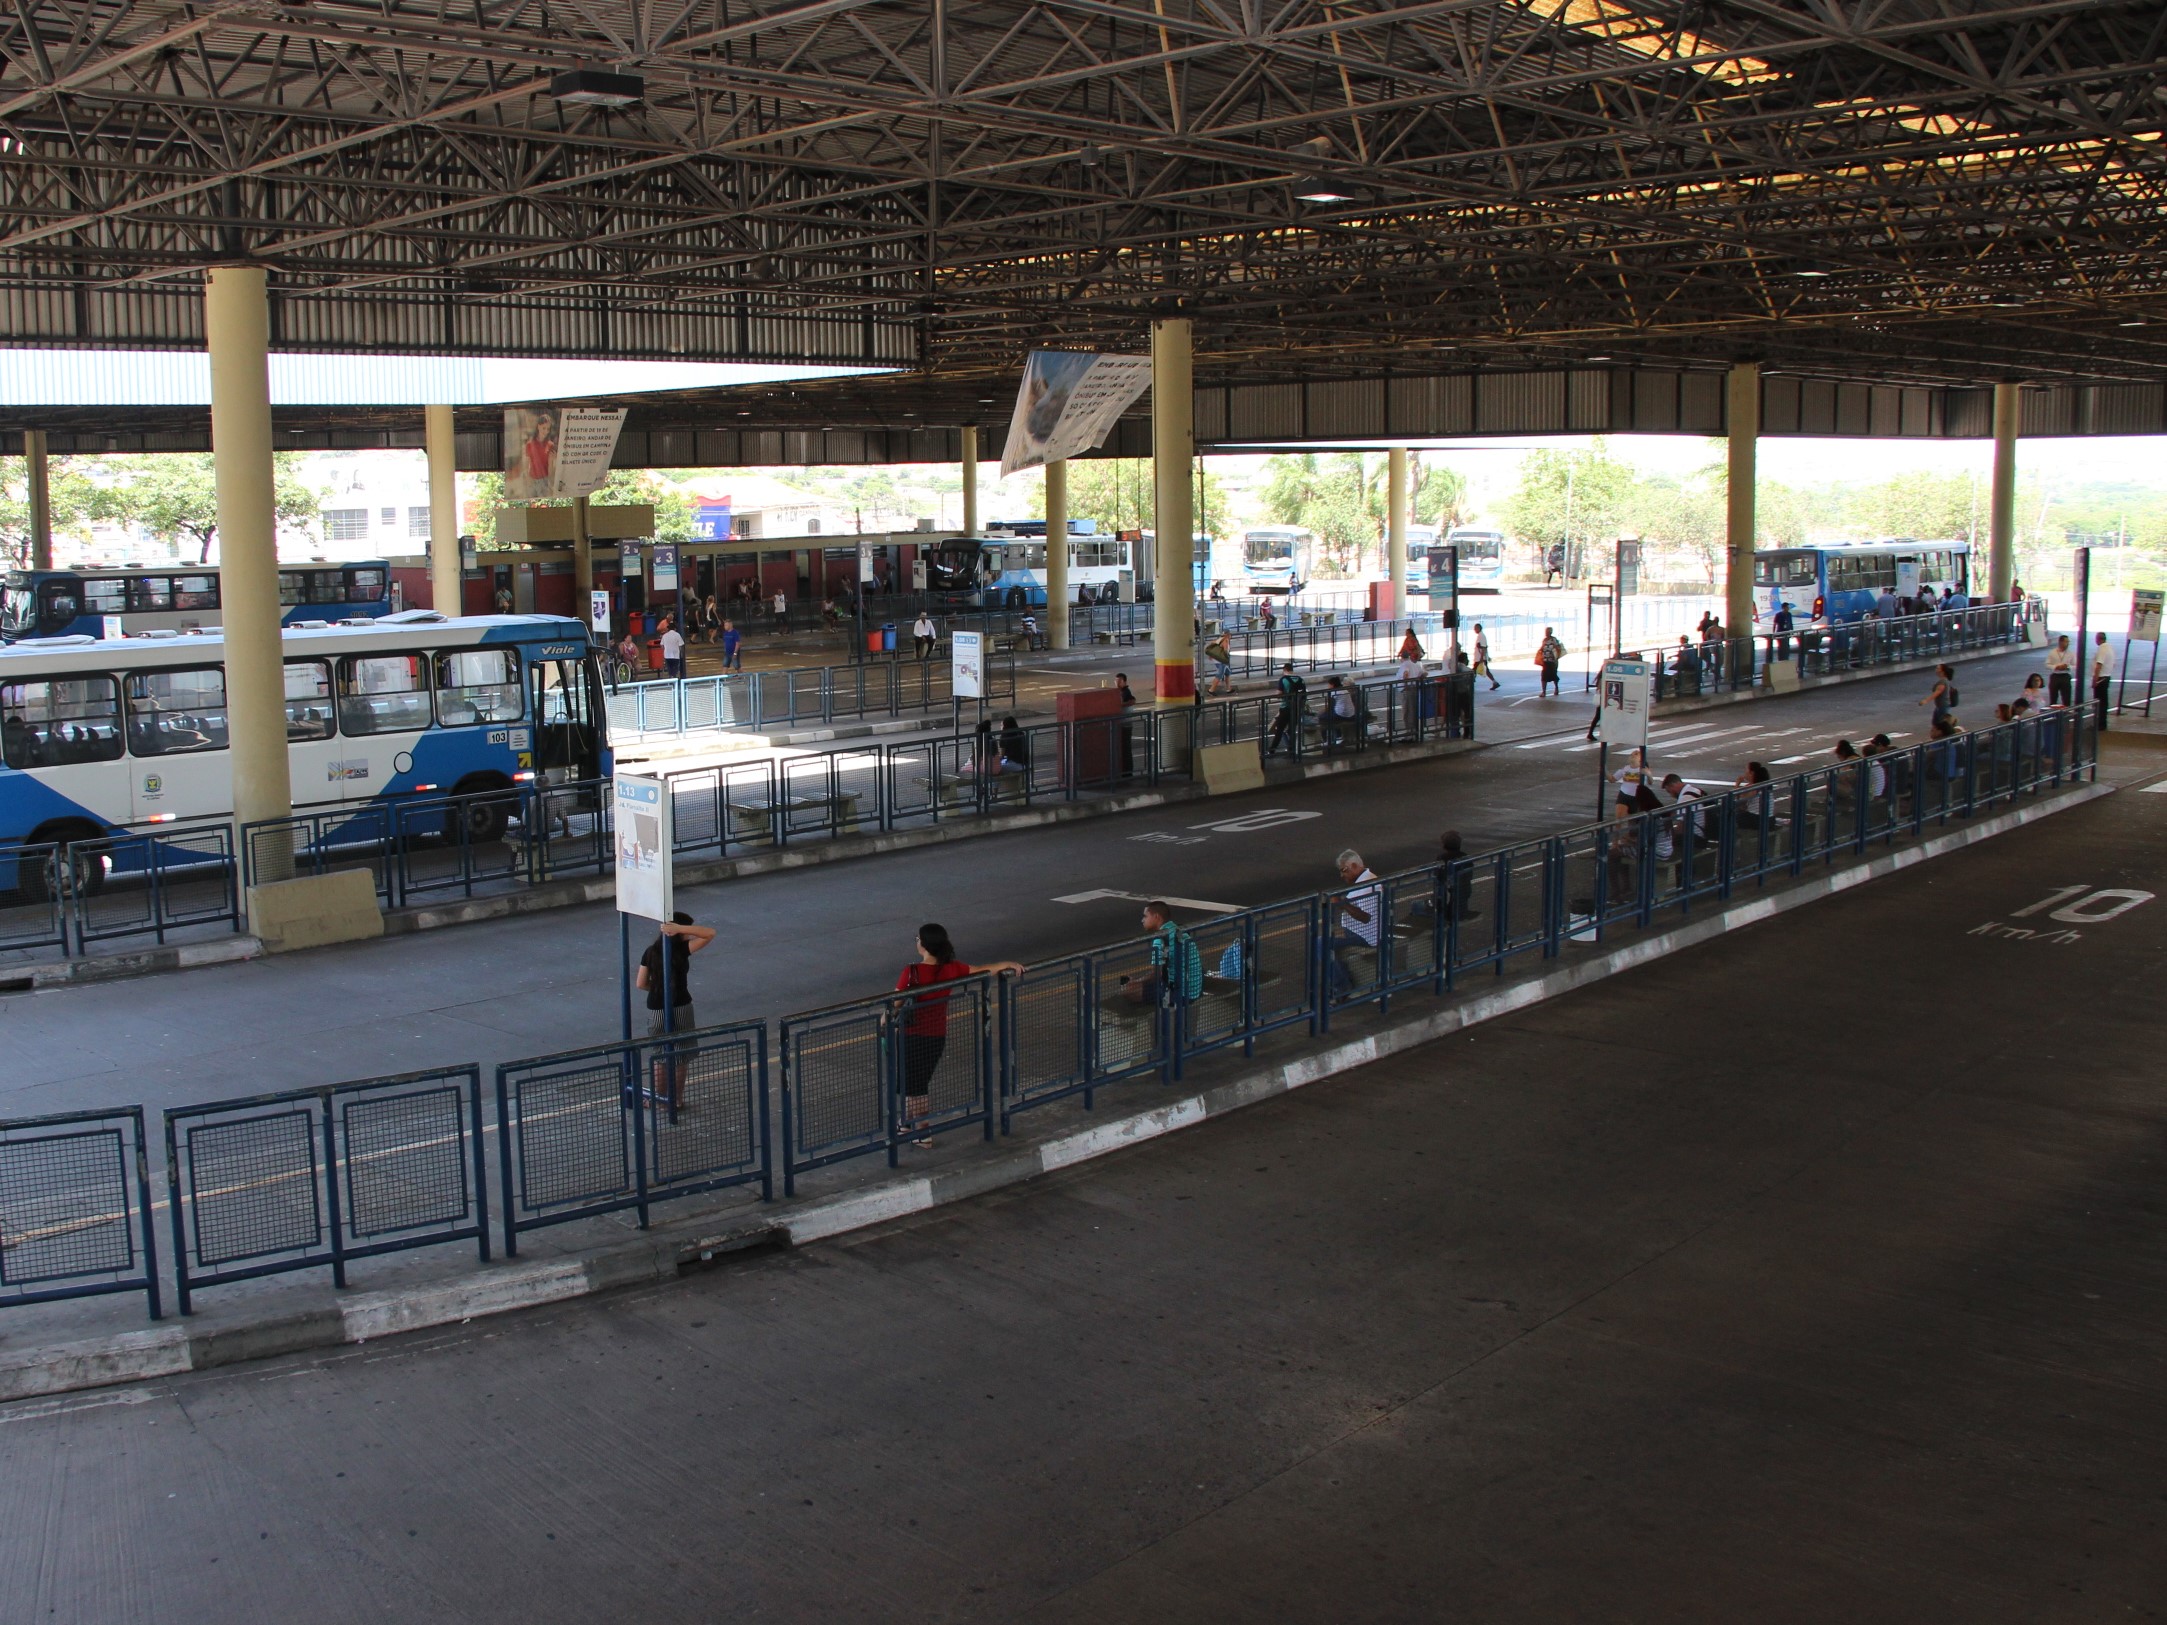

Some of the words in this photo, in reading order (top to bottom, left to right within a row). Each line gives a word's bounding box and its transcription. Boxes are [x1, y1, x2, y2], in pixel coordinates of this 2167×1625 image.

[465, 541, 469, 549] 1
[624, 545, 630, 554] 2
[666, 552, 673, 563] 3
[861, 547, 866, 557] 3
[1622, 550, 1629, 563] 4
[1441, 558, 1450, 572] 4
[541, 645, 575, 655] Viale
[492, 733, 506, 742] 103
[619, 785, 634, 797] 1.13
[1186, 809, 1323, 832] 10
[2009, 885, 2156, 922] 10
